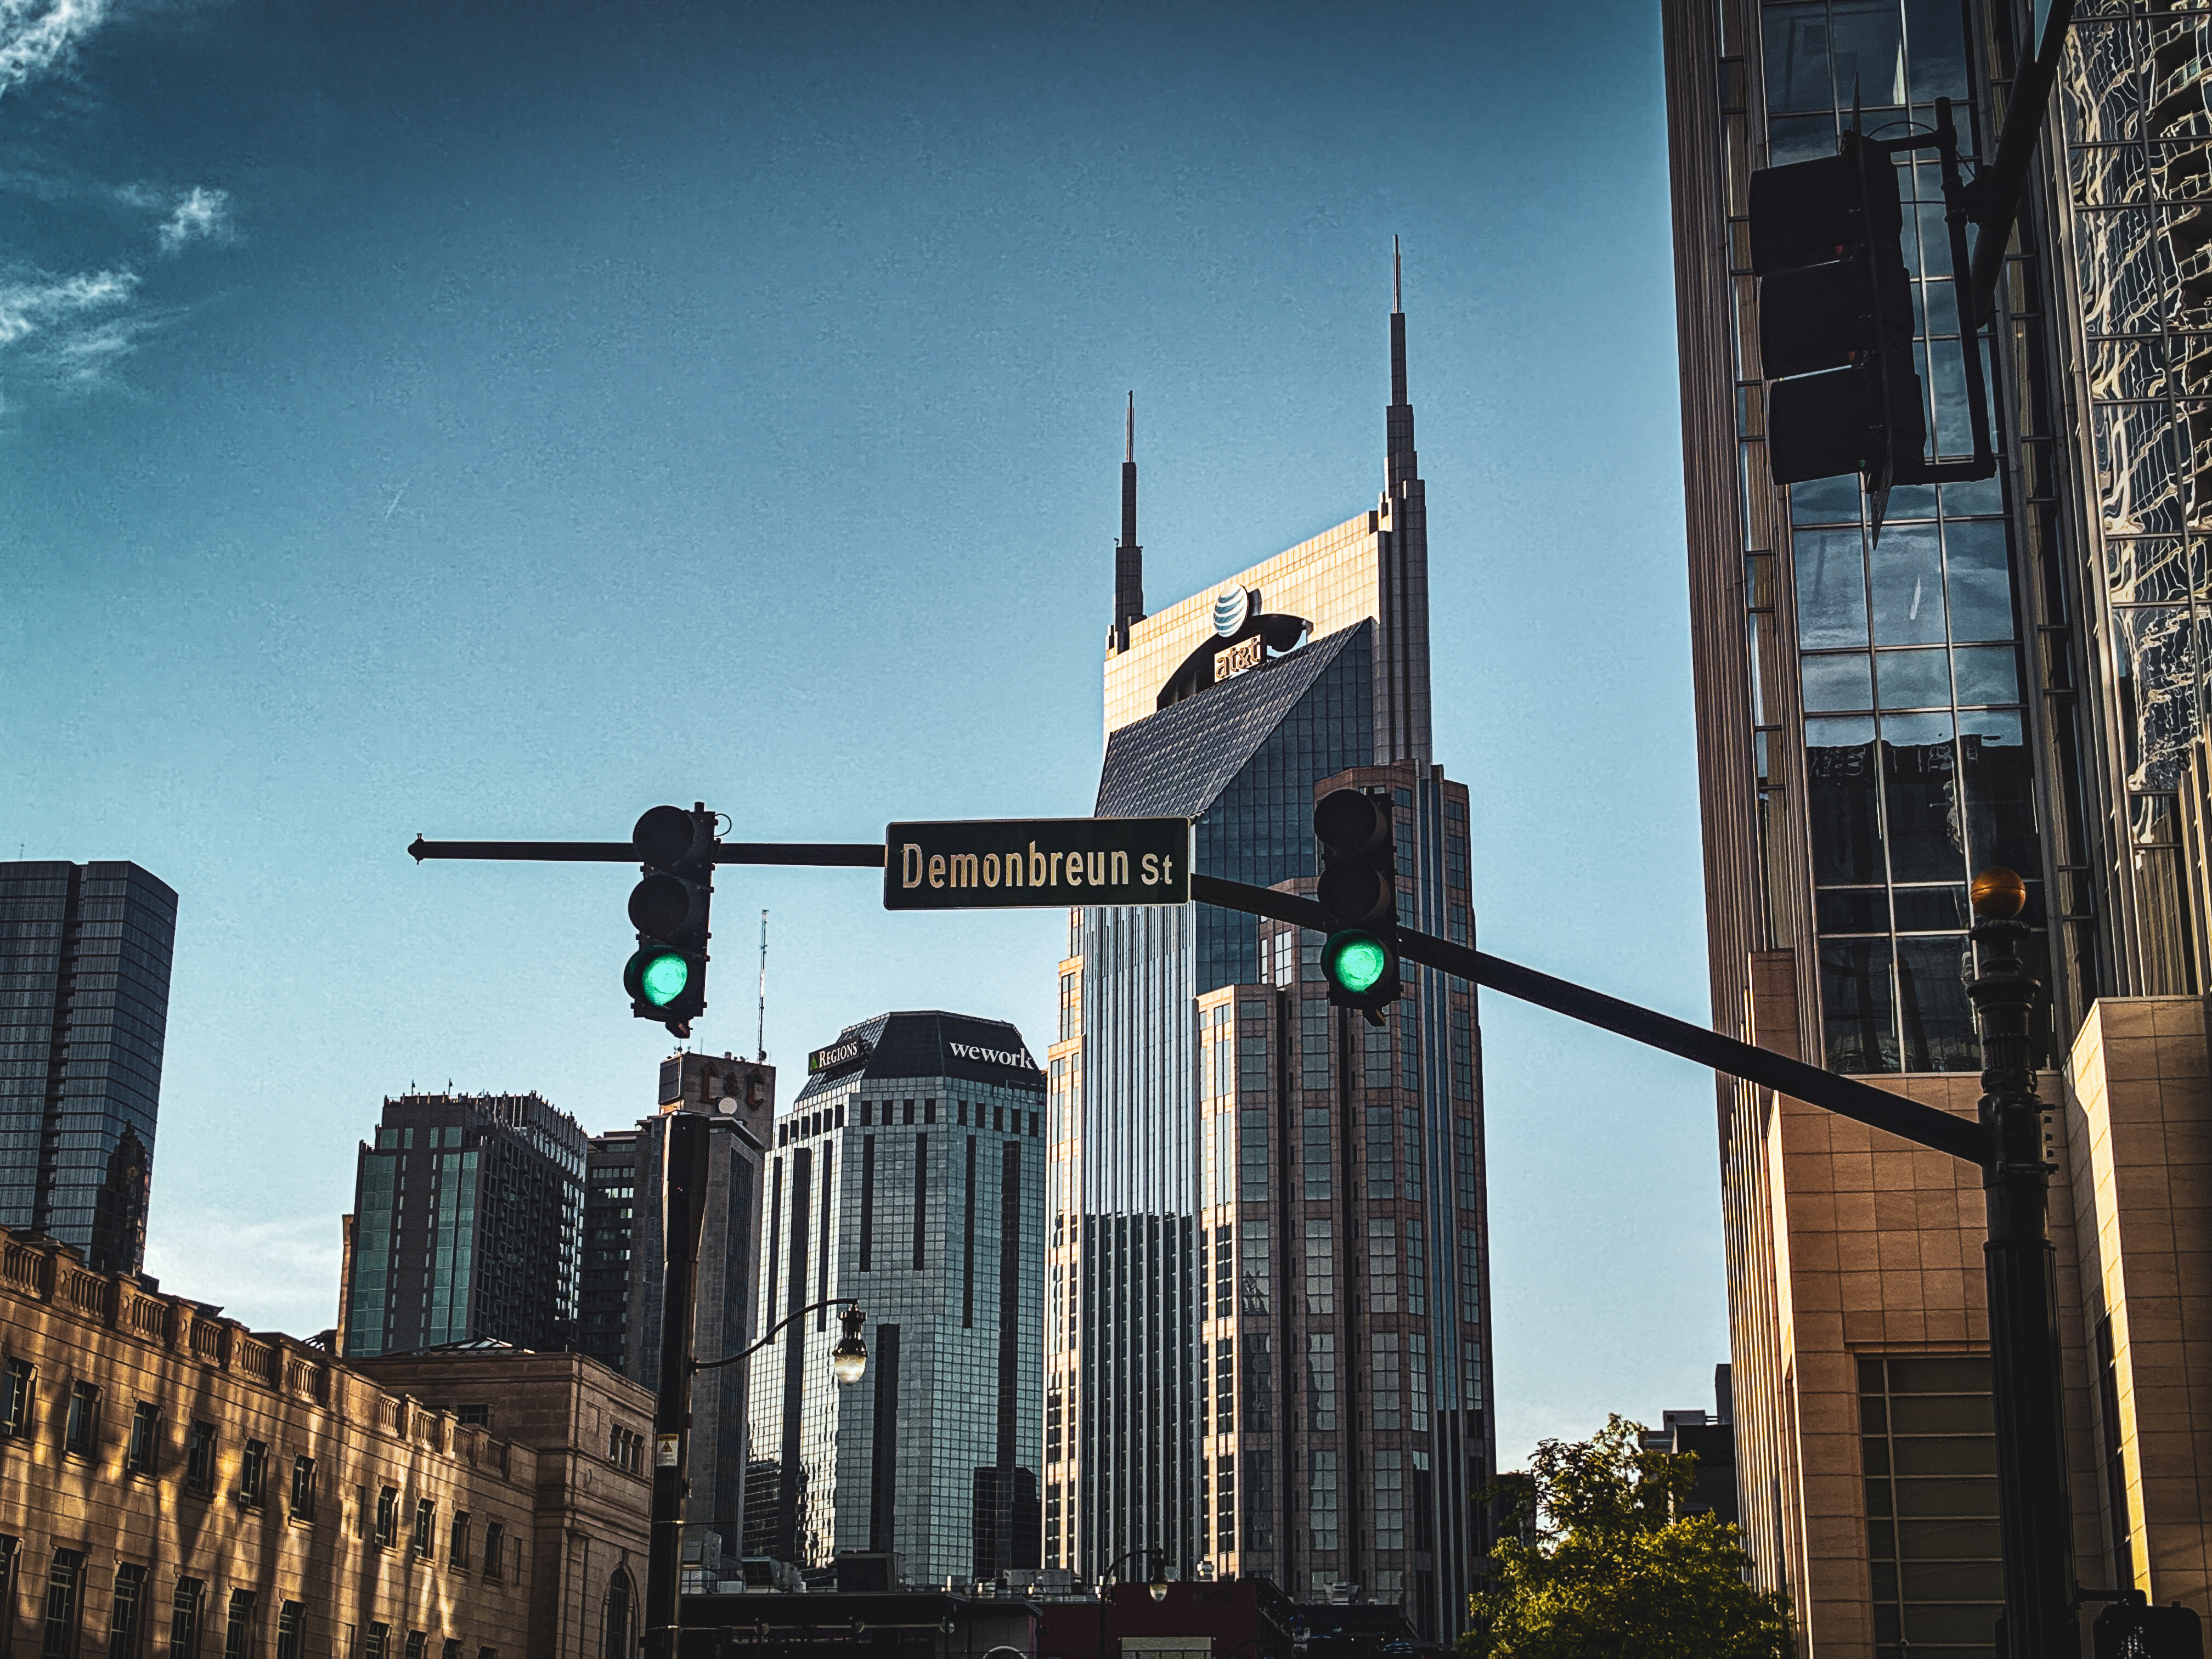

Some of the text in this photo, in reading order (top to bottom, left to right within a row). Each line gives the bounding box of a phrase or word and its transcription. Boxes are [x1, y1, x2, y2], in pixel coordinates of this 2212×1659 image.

[1216, 637, 1260, 679] at&t
[902, 840, 1173, 889] Demonbreun St
[819, 1041, 857, 1068] REGIONS
[949, 1042, 1034, 1070] wework
